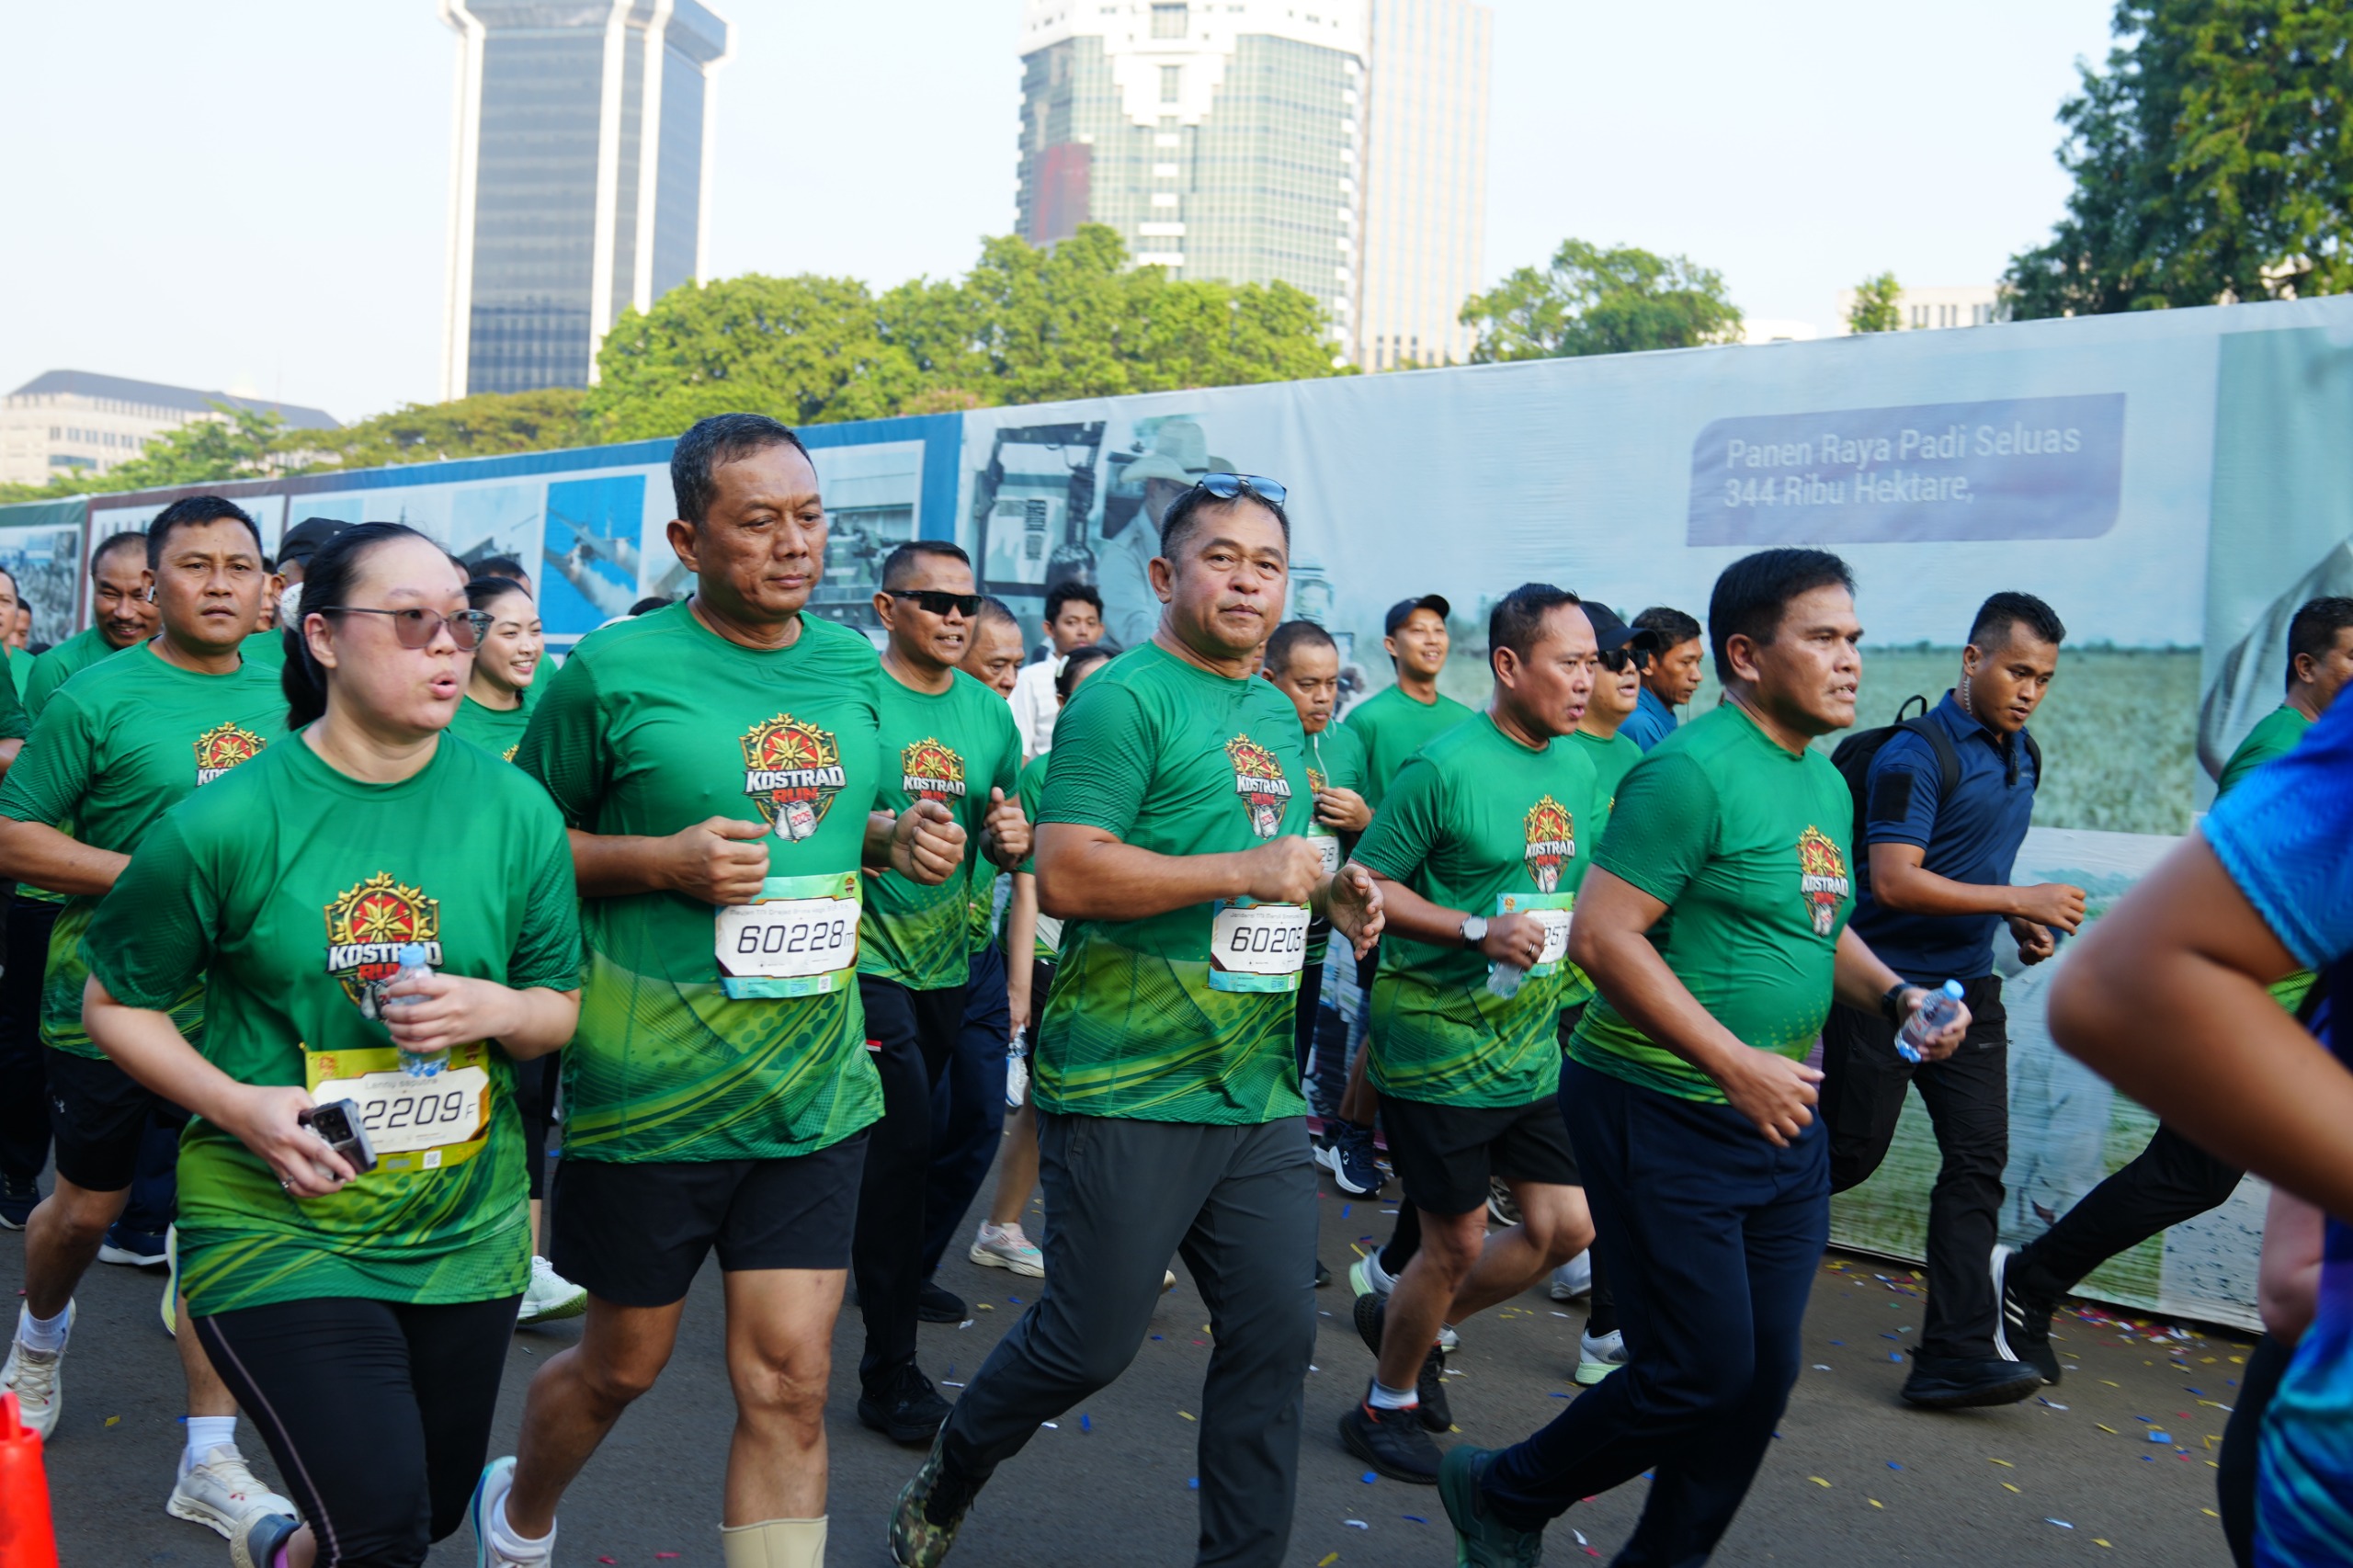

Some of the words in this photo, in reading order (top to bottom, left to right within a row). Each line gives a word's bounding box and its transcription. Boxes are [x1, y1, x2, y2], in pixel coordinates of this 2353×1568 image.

[1726, 438, 1813, 469] Panen
[1821, 433, 1891, 471] Raya
[1899, 424, 1968, 460] Padi
[1974, 420, 2082, 457] Seluas
[1724, 477, 1778, 507] 344
[1783, 472, 1846, 506] Ribu
[745, 765, 847, 793] KOSTRAD
[903, 775, 966, 797] KOSTRAD
[1236, 774, 1292, 797] KOSTRAD
[773, 787, 818, 803] RUN
[1524, 839, 1575, 860] KOSTRAD
[737, 919, 845, 954] 60228
[355, 1091, 463, 1131] 2209
